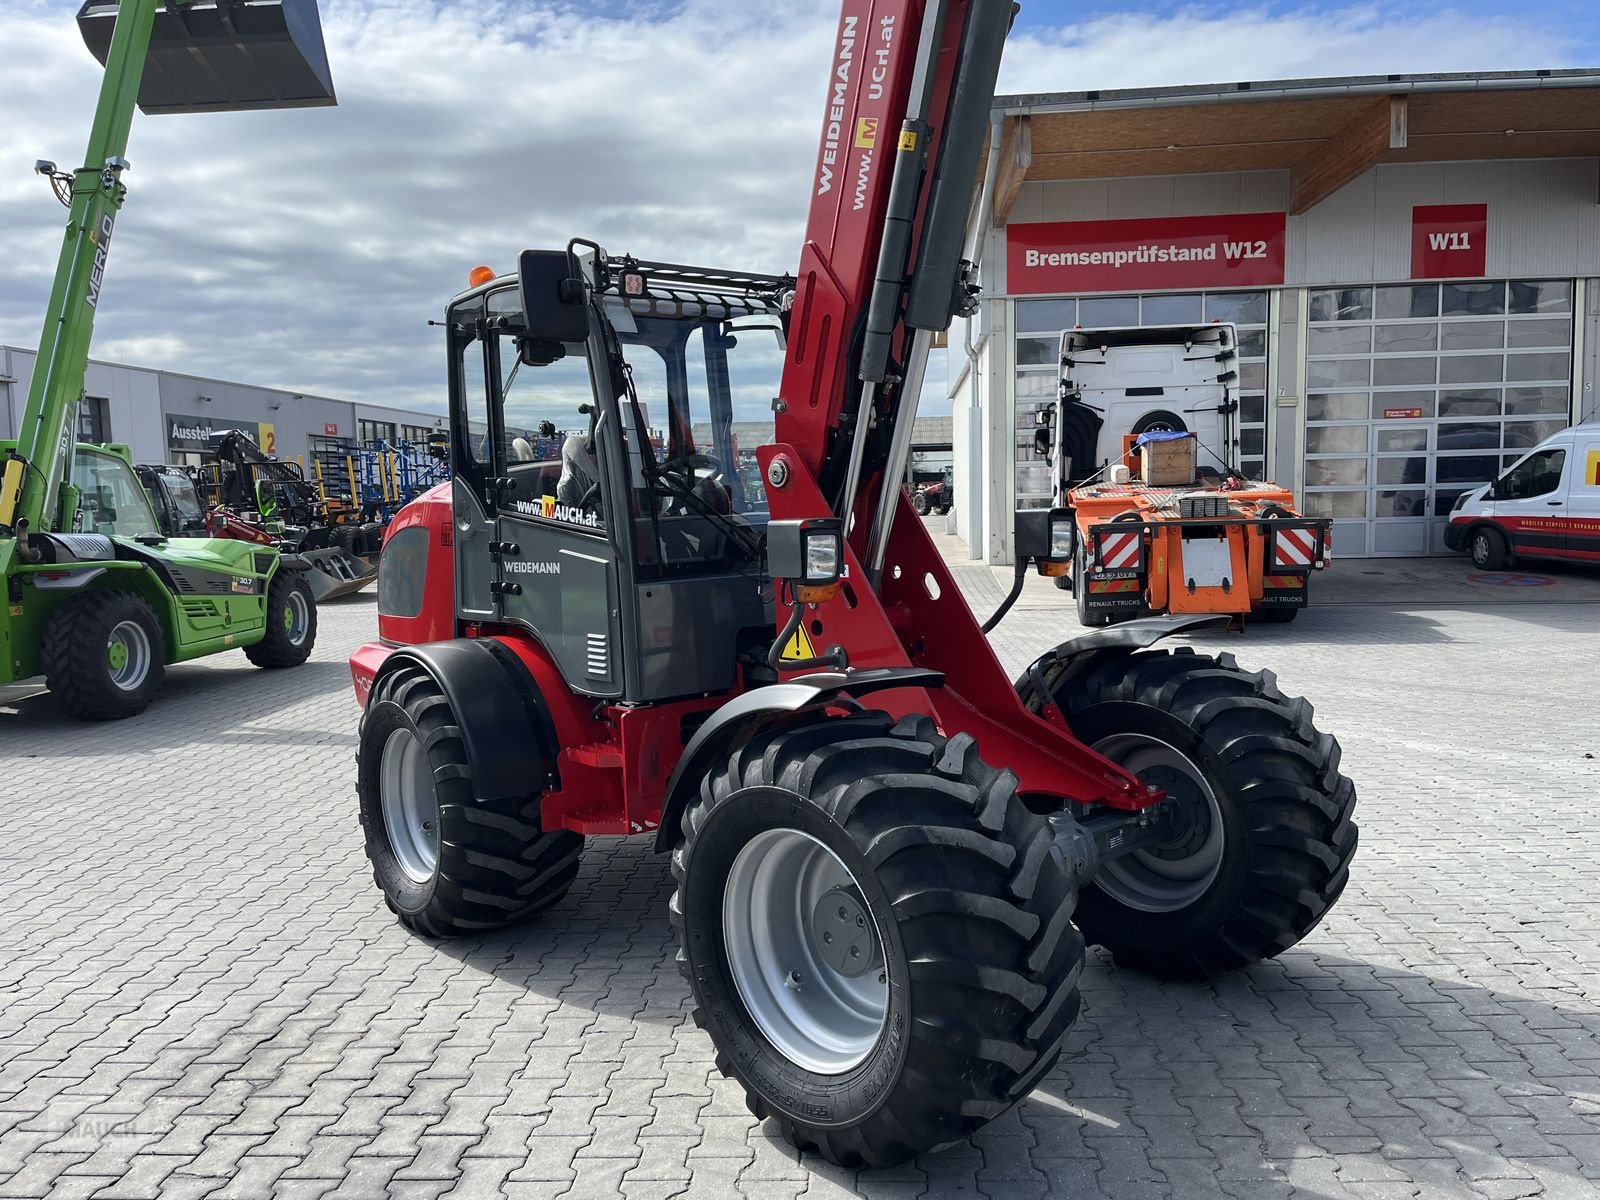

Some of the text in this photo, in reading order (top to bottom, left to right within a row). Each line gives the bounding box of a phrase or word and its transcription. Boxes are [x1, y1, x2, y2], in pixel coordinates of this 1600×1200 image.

[818, 16, 858, 195] WEIDEMANN
[1025, 240, 1267, 268] Bremsenprüfstand W12
[1429, 232, 1470, 250] W11
[86, 213, 113, 308] MERLO
[60, 425, 70, 457] 30.7
[266, 432, 276, 454] 2
[517, 500, 597, 527] www.MAUCH.at
[504, 561, 560, 574] WEIDEMANN
[863, 1028, 900, 1105] ALLIANCE
